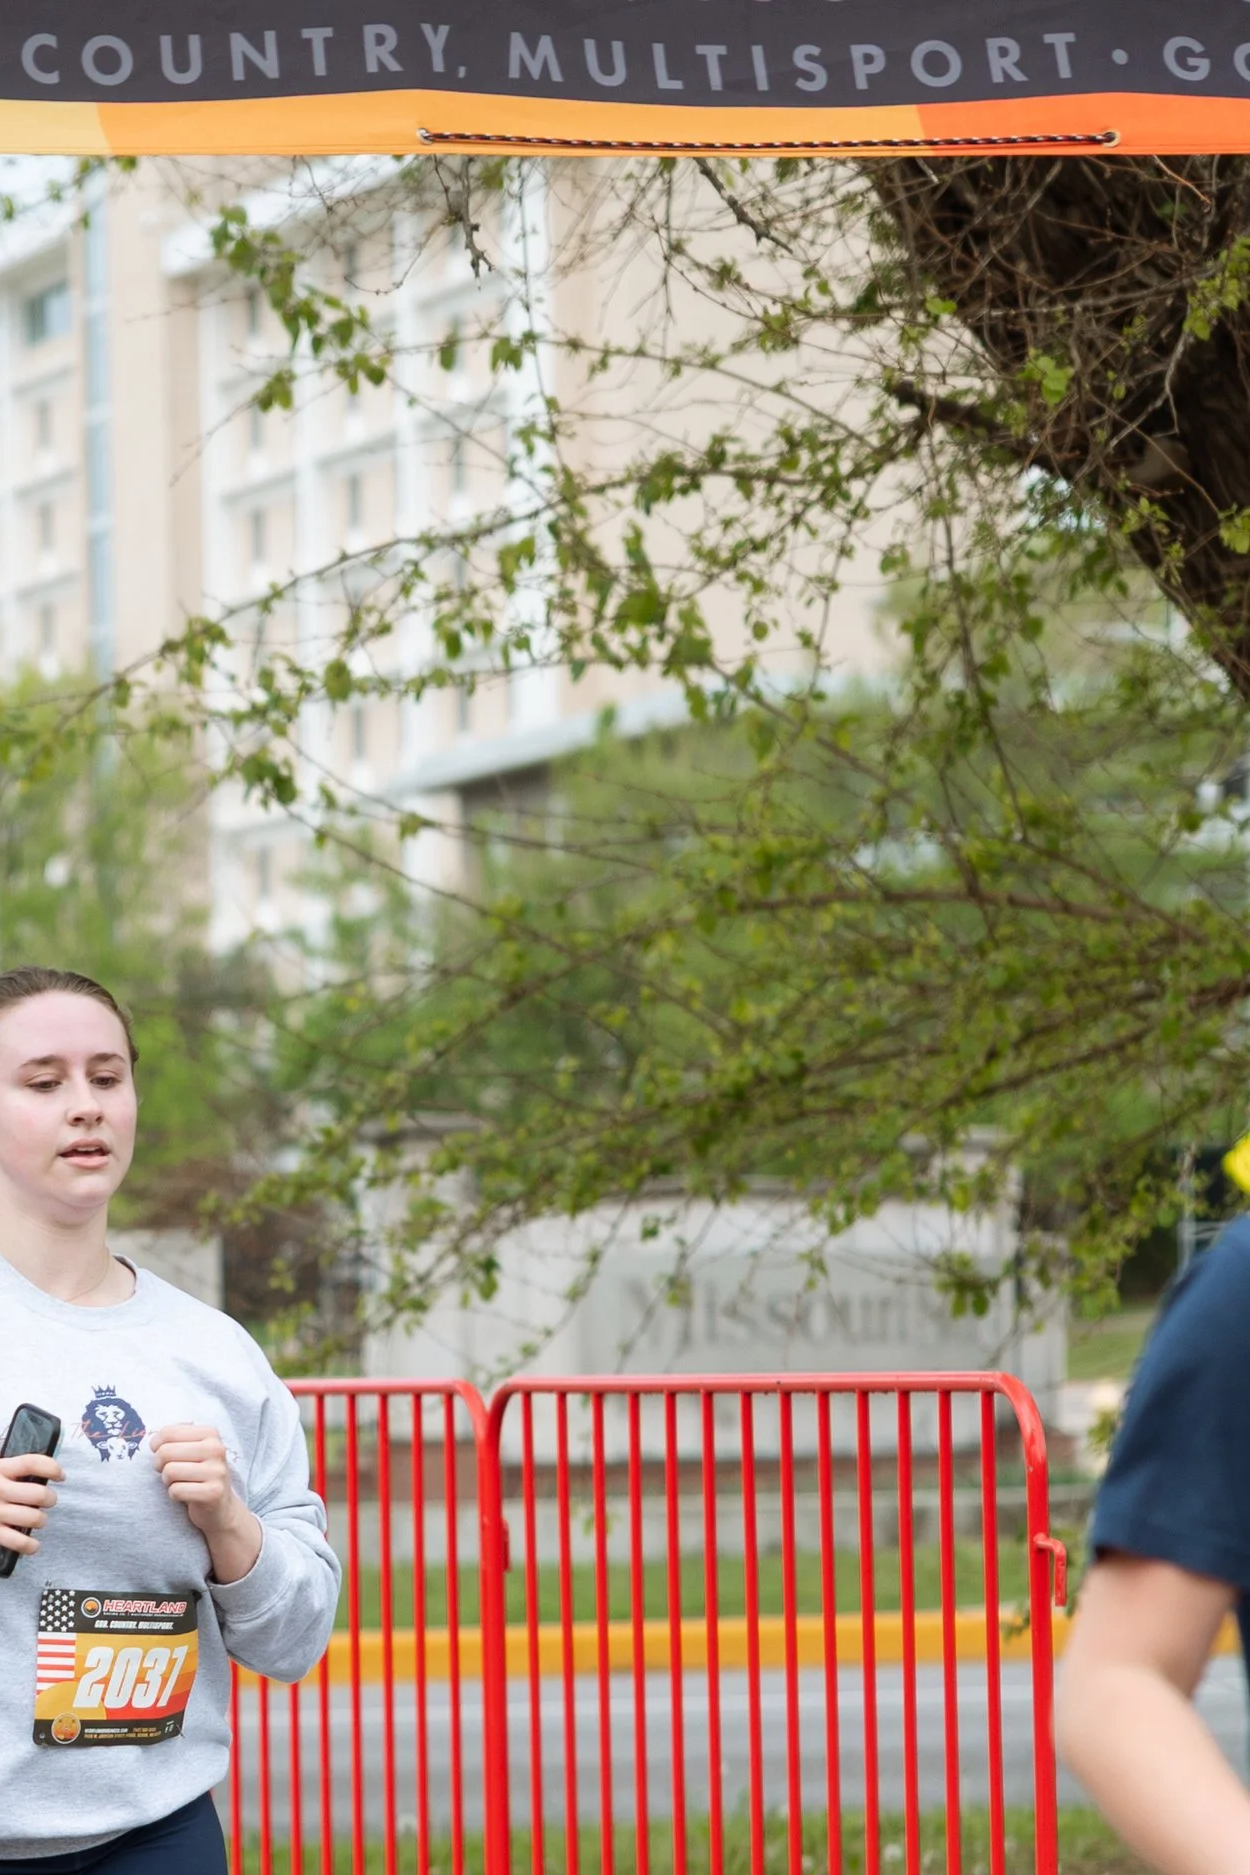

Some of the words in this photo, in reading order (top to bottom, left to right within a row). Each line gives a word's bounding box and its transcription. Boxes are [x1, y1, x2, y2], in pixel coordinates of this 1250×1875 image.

[21, 23, 466, 87] COUNTRY,
[508, 31, 1076, 92] MULTISPORT
[103, 1599, 187, 1614] HEARTLAND
[72, 1645, 188, 1709] 2031
